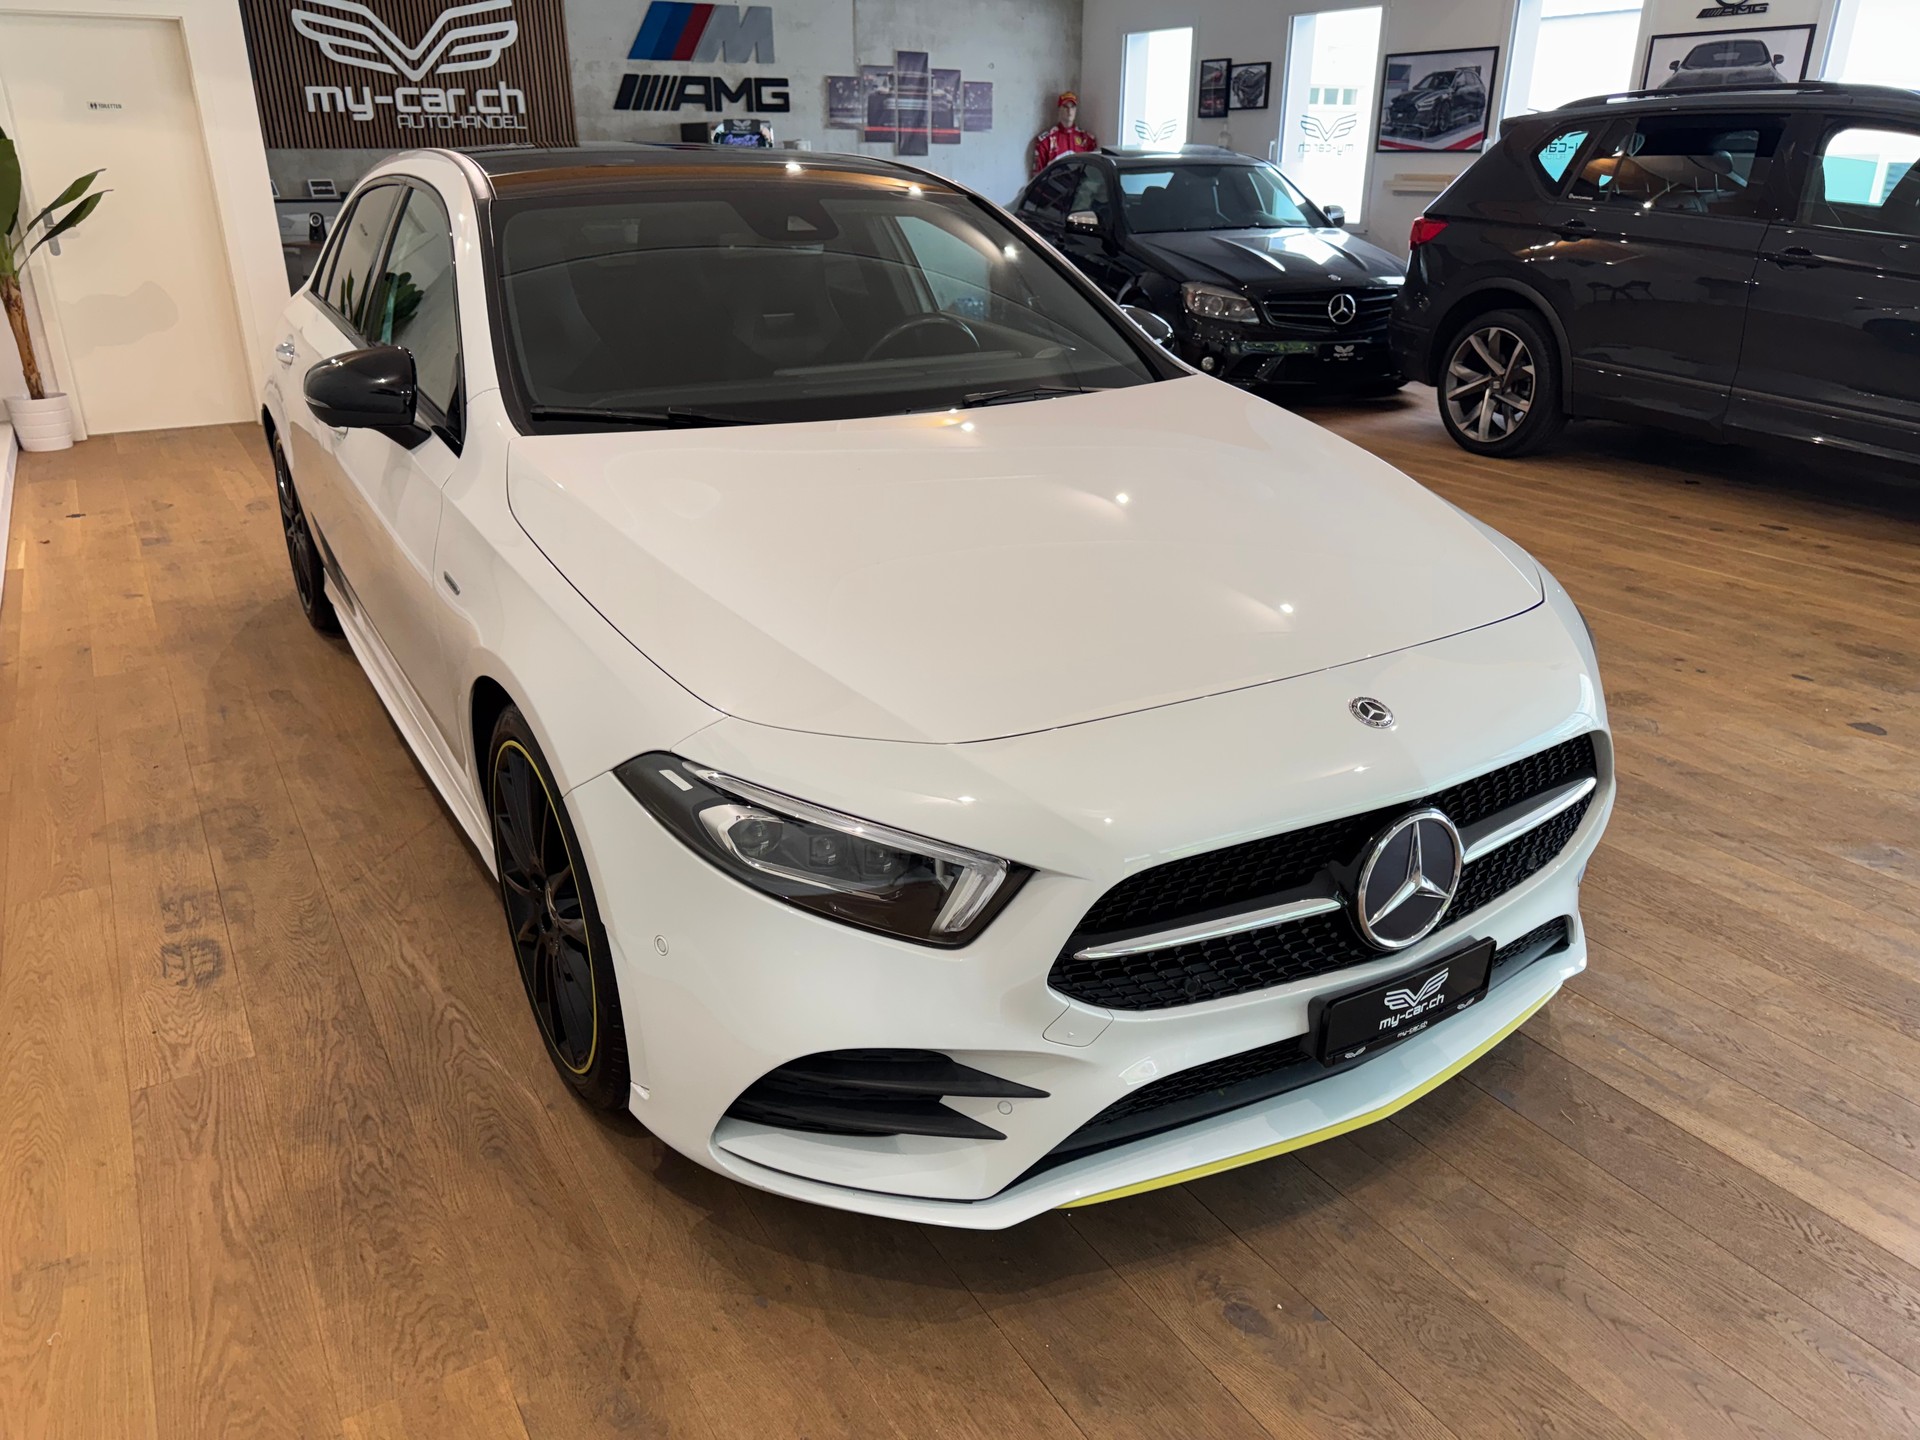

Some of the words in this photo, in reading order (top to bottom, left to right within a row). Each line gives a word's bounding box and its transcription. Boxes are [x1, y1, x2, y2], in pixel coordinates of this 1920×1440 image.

[304, 81, 526, 121] my-car.ch
[671, 75, 790, 113] AMG
[397, 114, 527, 129] AUTOHANDEL
[1379, 993, 1445, 1030] my-car.ch
